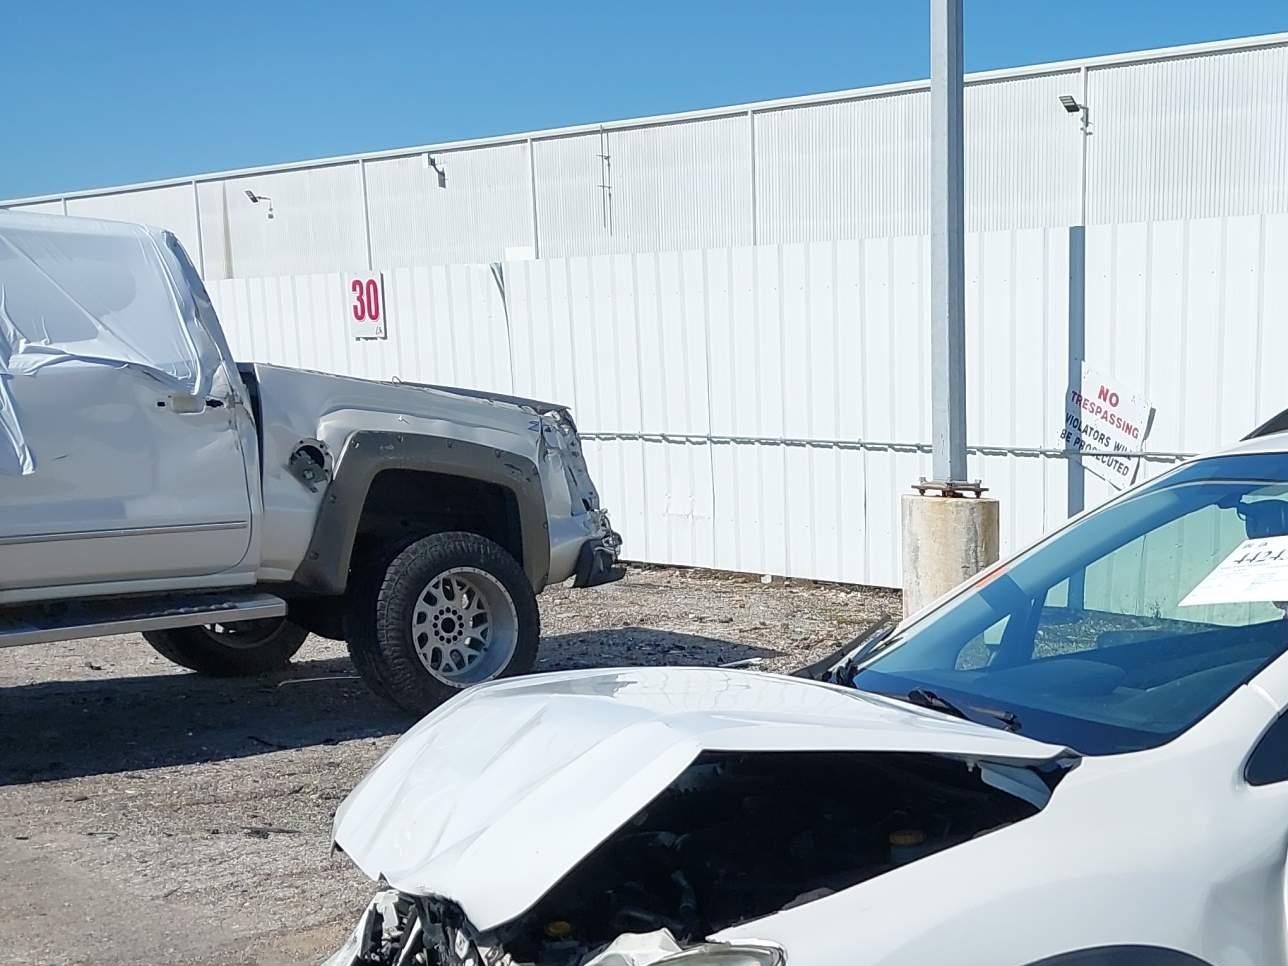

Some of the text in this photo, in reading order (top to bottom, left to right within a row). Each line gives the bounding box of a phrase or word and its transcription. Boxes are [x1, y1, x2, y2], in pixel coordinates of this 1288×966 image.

[352, 279, 379, 320] 30
[1098, 385, 1120, 407] NO
[1065, 413, 1112, 447] VIOLATORS
[1071, 391, 1140, 439] TRESPASSING
[1060, 429, 1073, 443] BE
